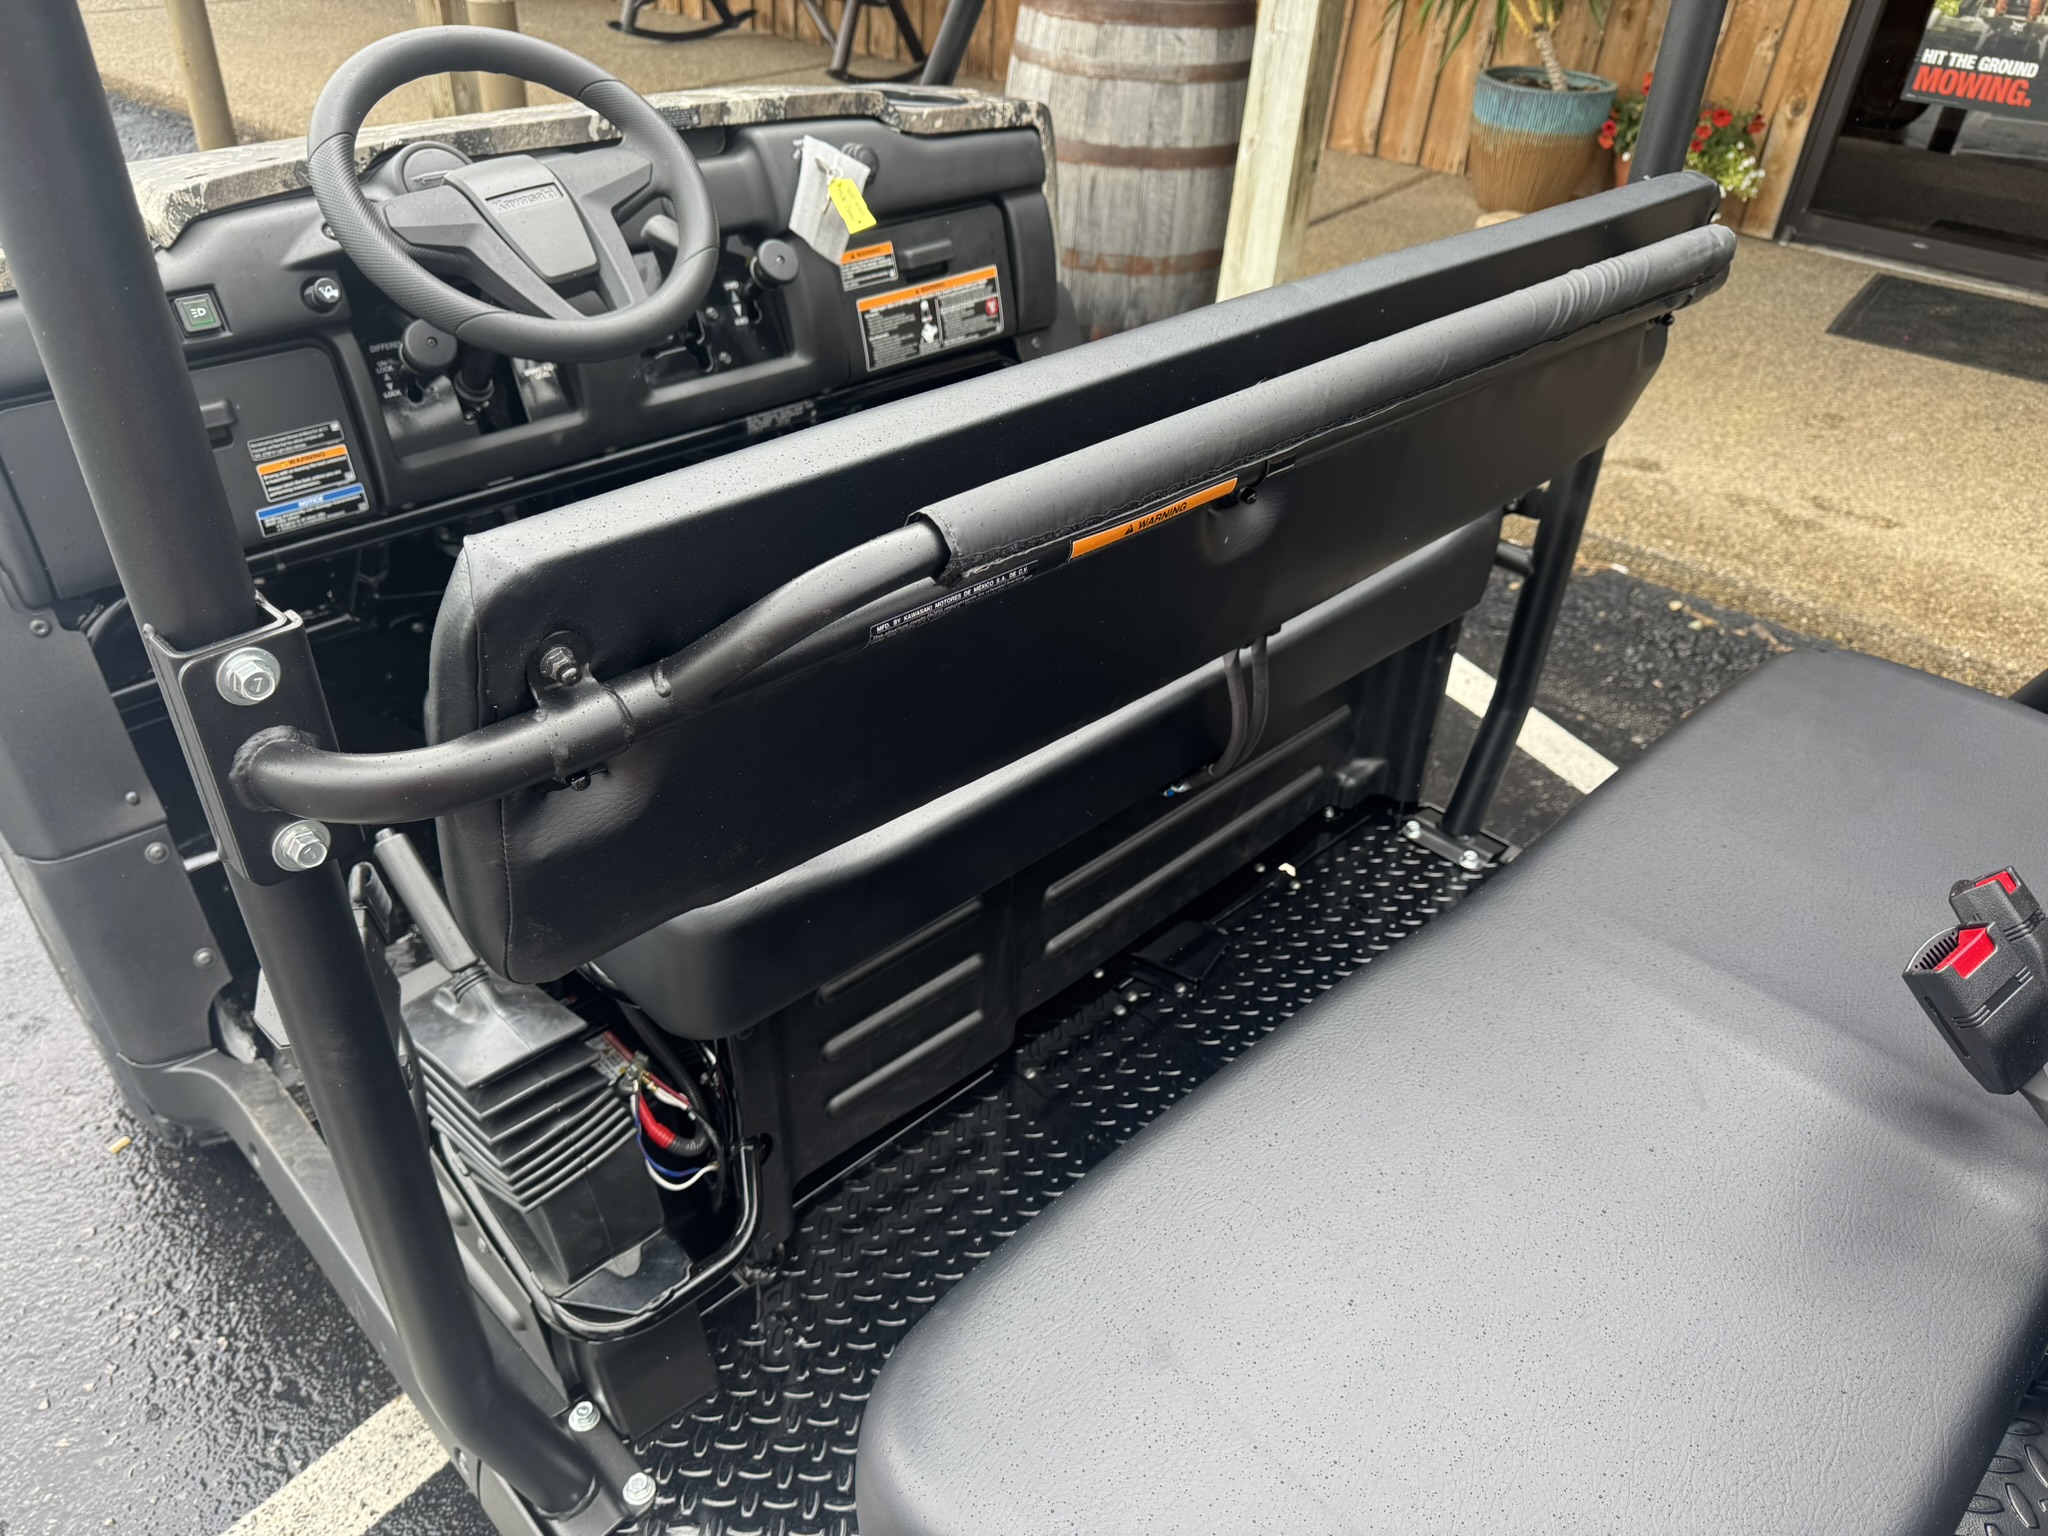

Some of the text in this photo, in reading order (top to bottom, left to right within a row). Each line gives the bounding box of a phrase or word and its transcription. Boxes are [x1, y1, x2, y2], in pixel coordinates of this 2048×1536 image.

[1921, 48, 2039, 78] HIT THE GROUND
[1912, 65, 2032, 108] MOWING.
[491, 187, 558, 211] Kawasaki
[1138, 501, 1188, 530] WARNING
[876, 622, 890, 633] MFD.
[892, 617, 901, 627] BY
[903, 605, 932, 621] KAWASAKI
[934, 593, 962, 609] MOTORES
[963, 589, 972, 597] DE
[1009, 570, 1017, 579] DE
[253, 677, 264, 693] 7
